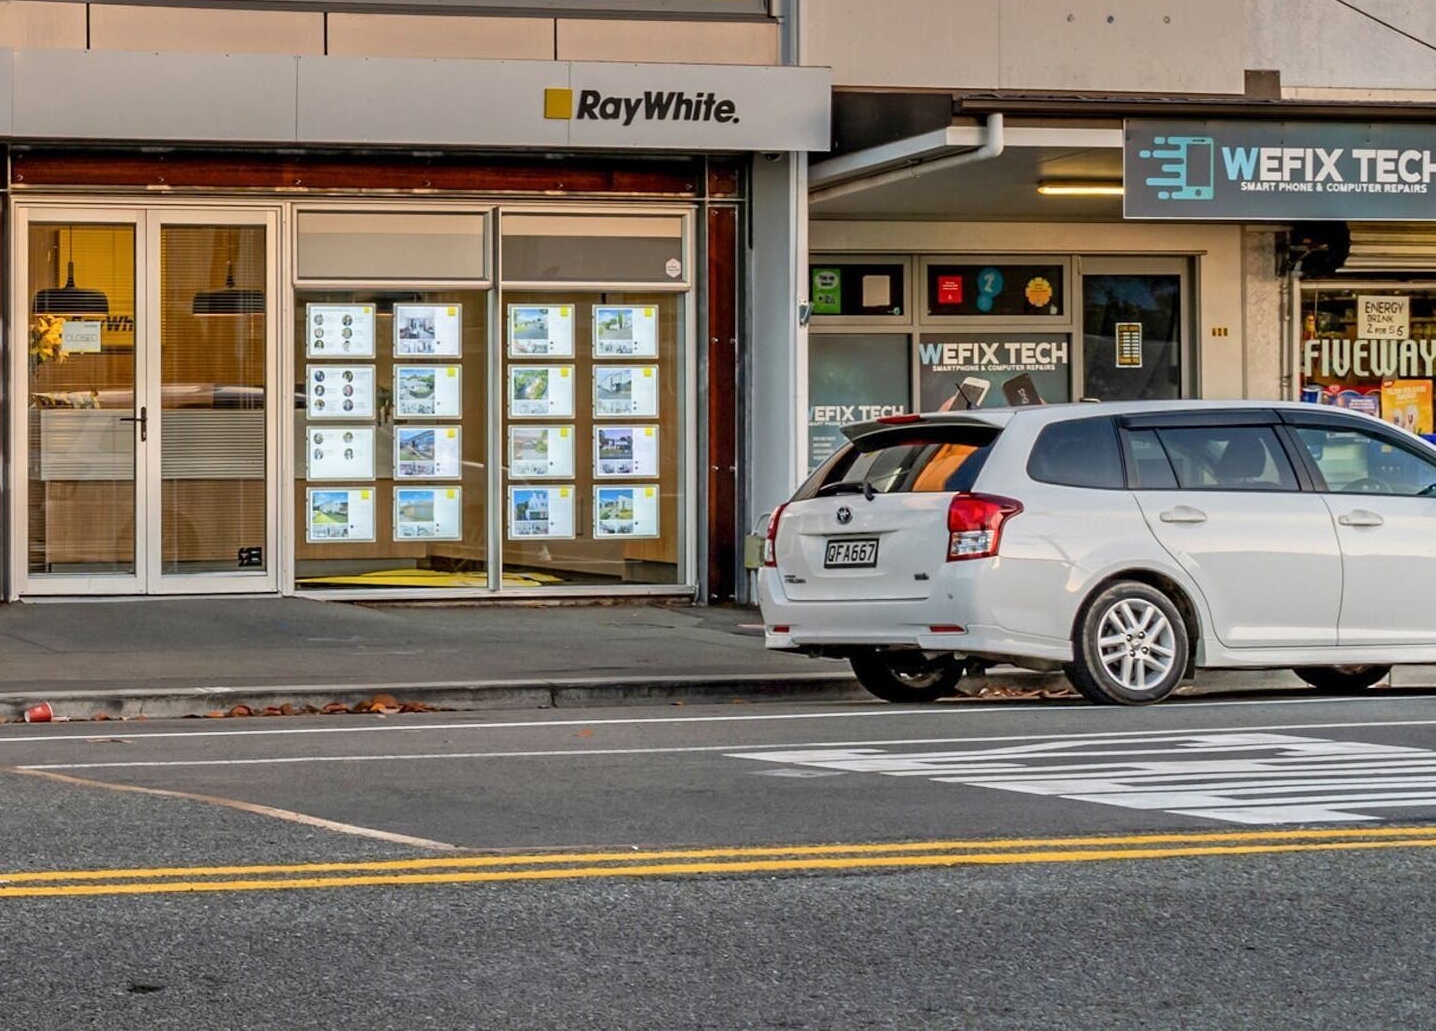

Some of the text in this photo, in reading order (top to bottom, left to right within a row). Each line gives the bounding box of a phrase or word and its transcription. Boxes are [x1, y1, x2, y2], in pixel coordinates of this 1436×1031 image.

[576, 89, 740, 127] RayWhite.
[1221, 146, 1436, 184] WEFIX TECH
[1240, 181, 1428, 193] SMART PHONE & COMPUTER REPAIRS
[1365, 301, 1404, 314] ENERGY
[1367, 314, 1394, 323] DRINK
[919, 342, 1068, 365] WEFIX TECH
[858, 404, 904, 421] TECH
[827, 543, 876, 562] QFA667
